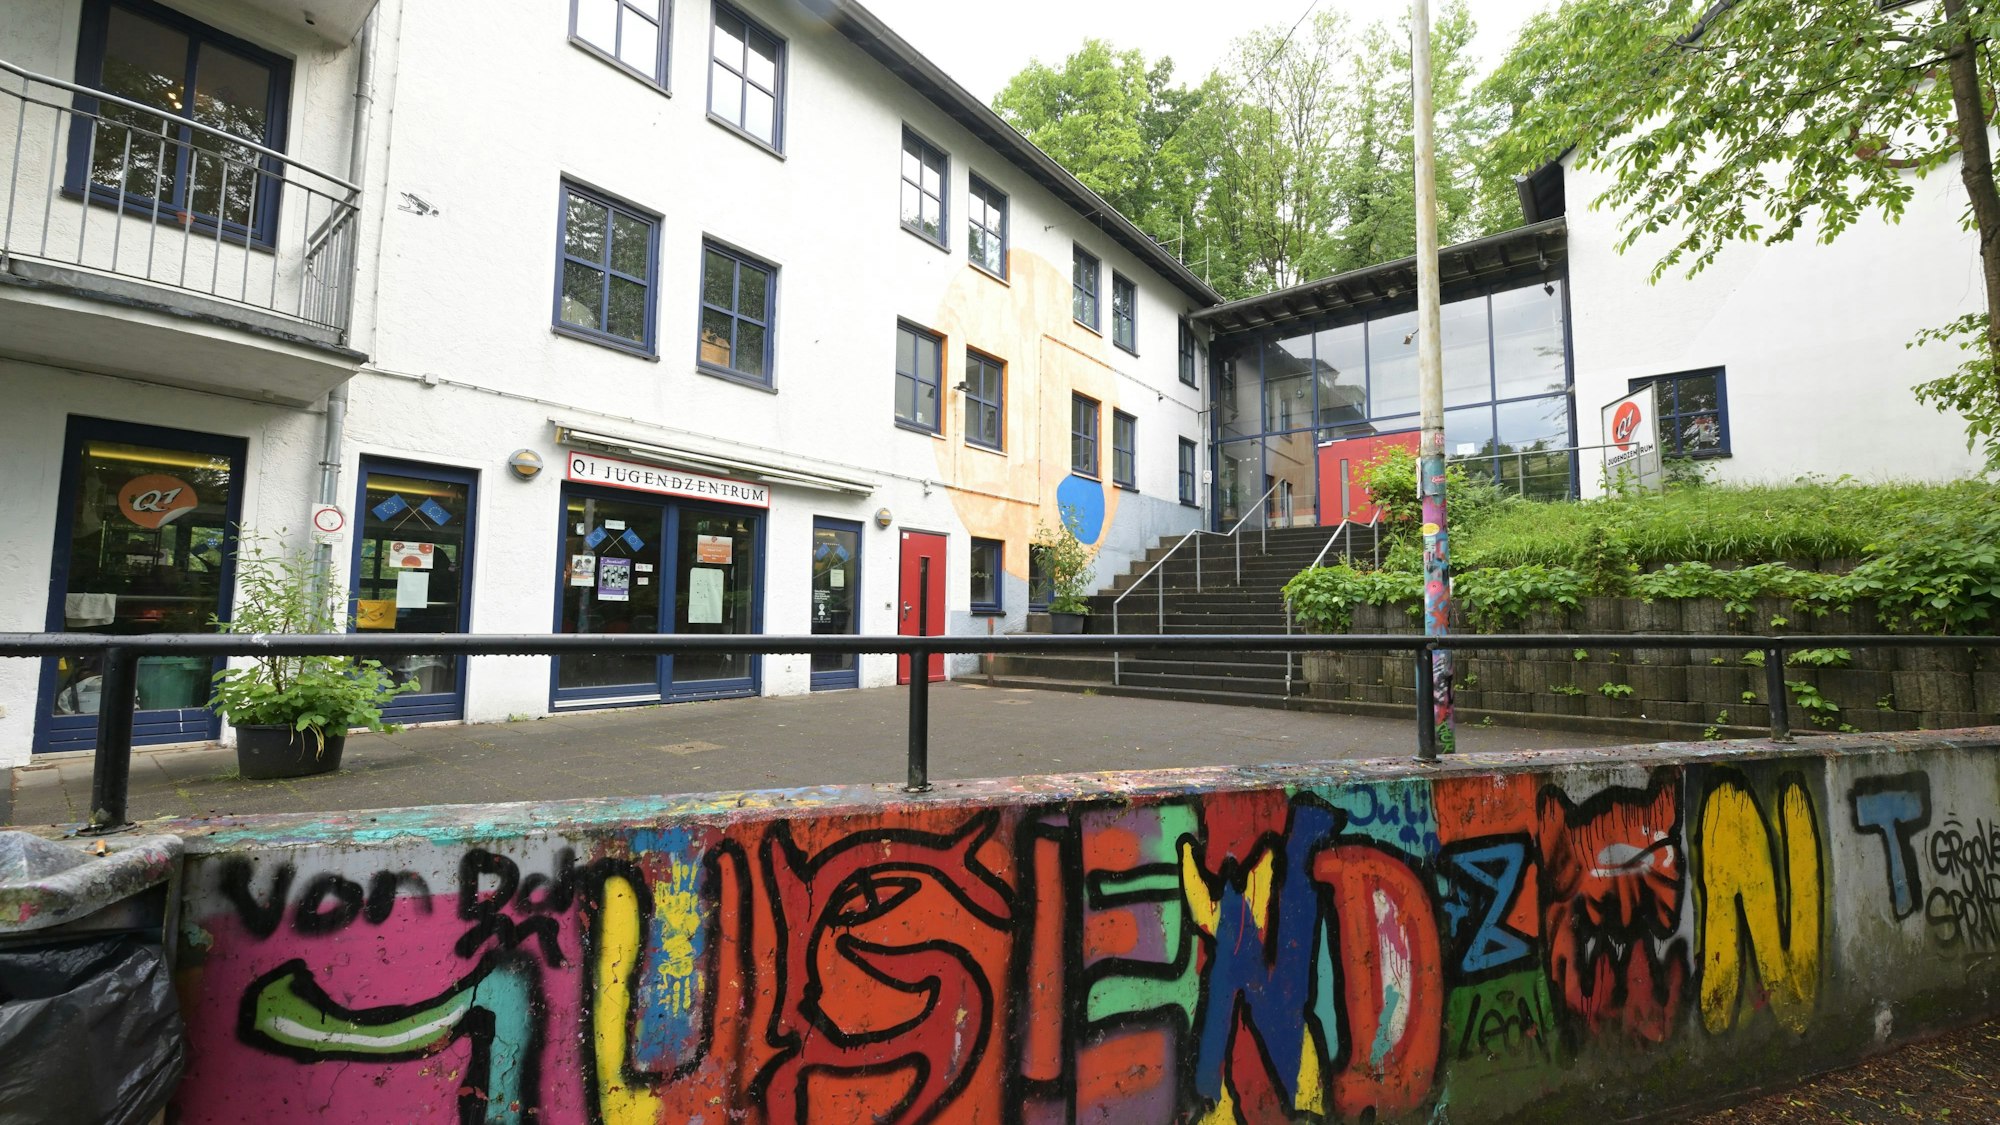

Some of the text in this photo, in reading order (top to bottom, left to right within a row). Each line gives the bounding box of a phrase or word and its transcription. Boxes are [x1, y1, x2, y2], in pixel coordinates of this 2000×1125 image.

[1617, 409, 1634, 440] Q1
[1608, 444, 1654, 466] JUGENDZENRUM
[573, 459, 765, 502] Q1 JUGENDZENTRUM
[132, 487, 182, 512] Q1
[1925, 886, 2000, 951] SPRA
